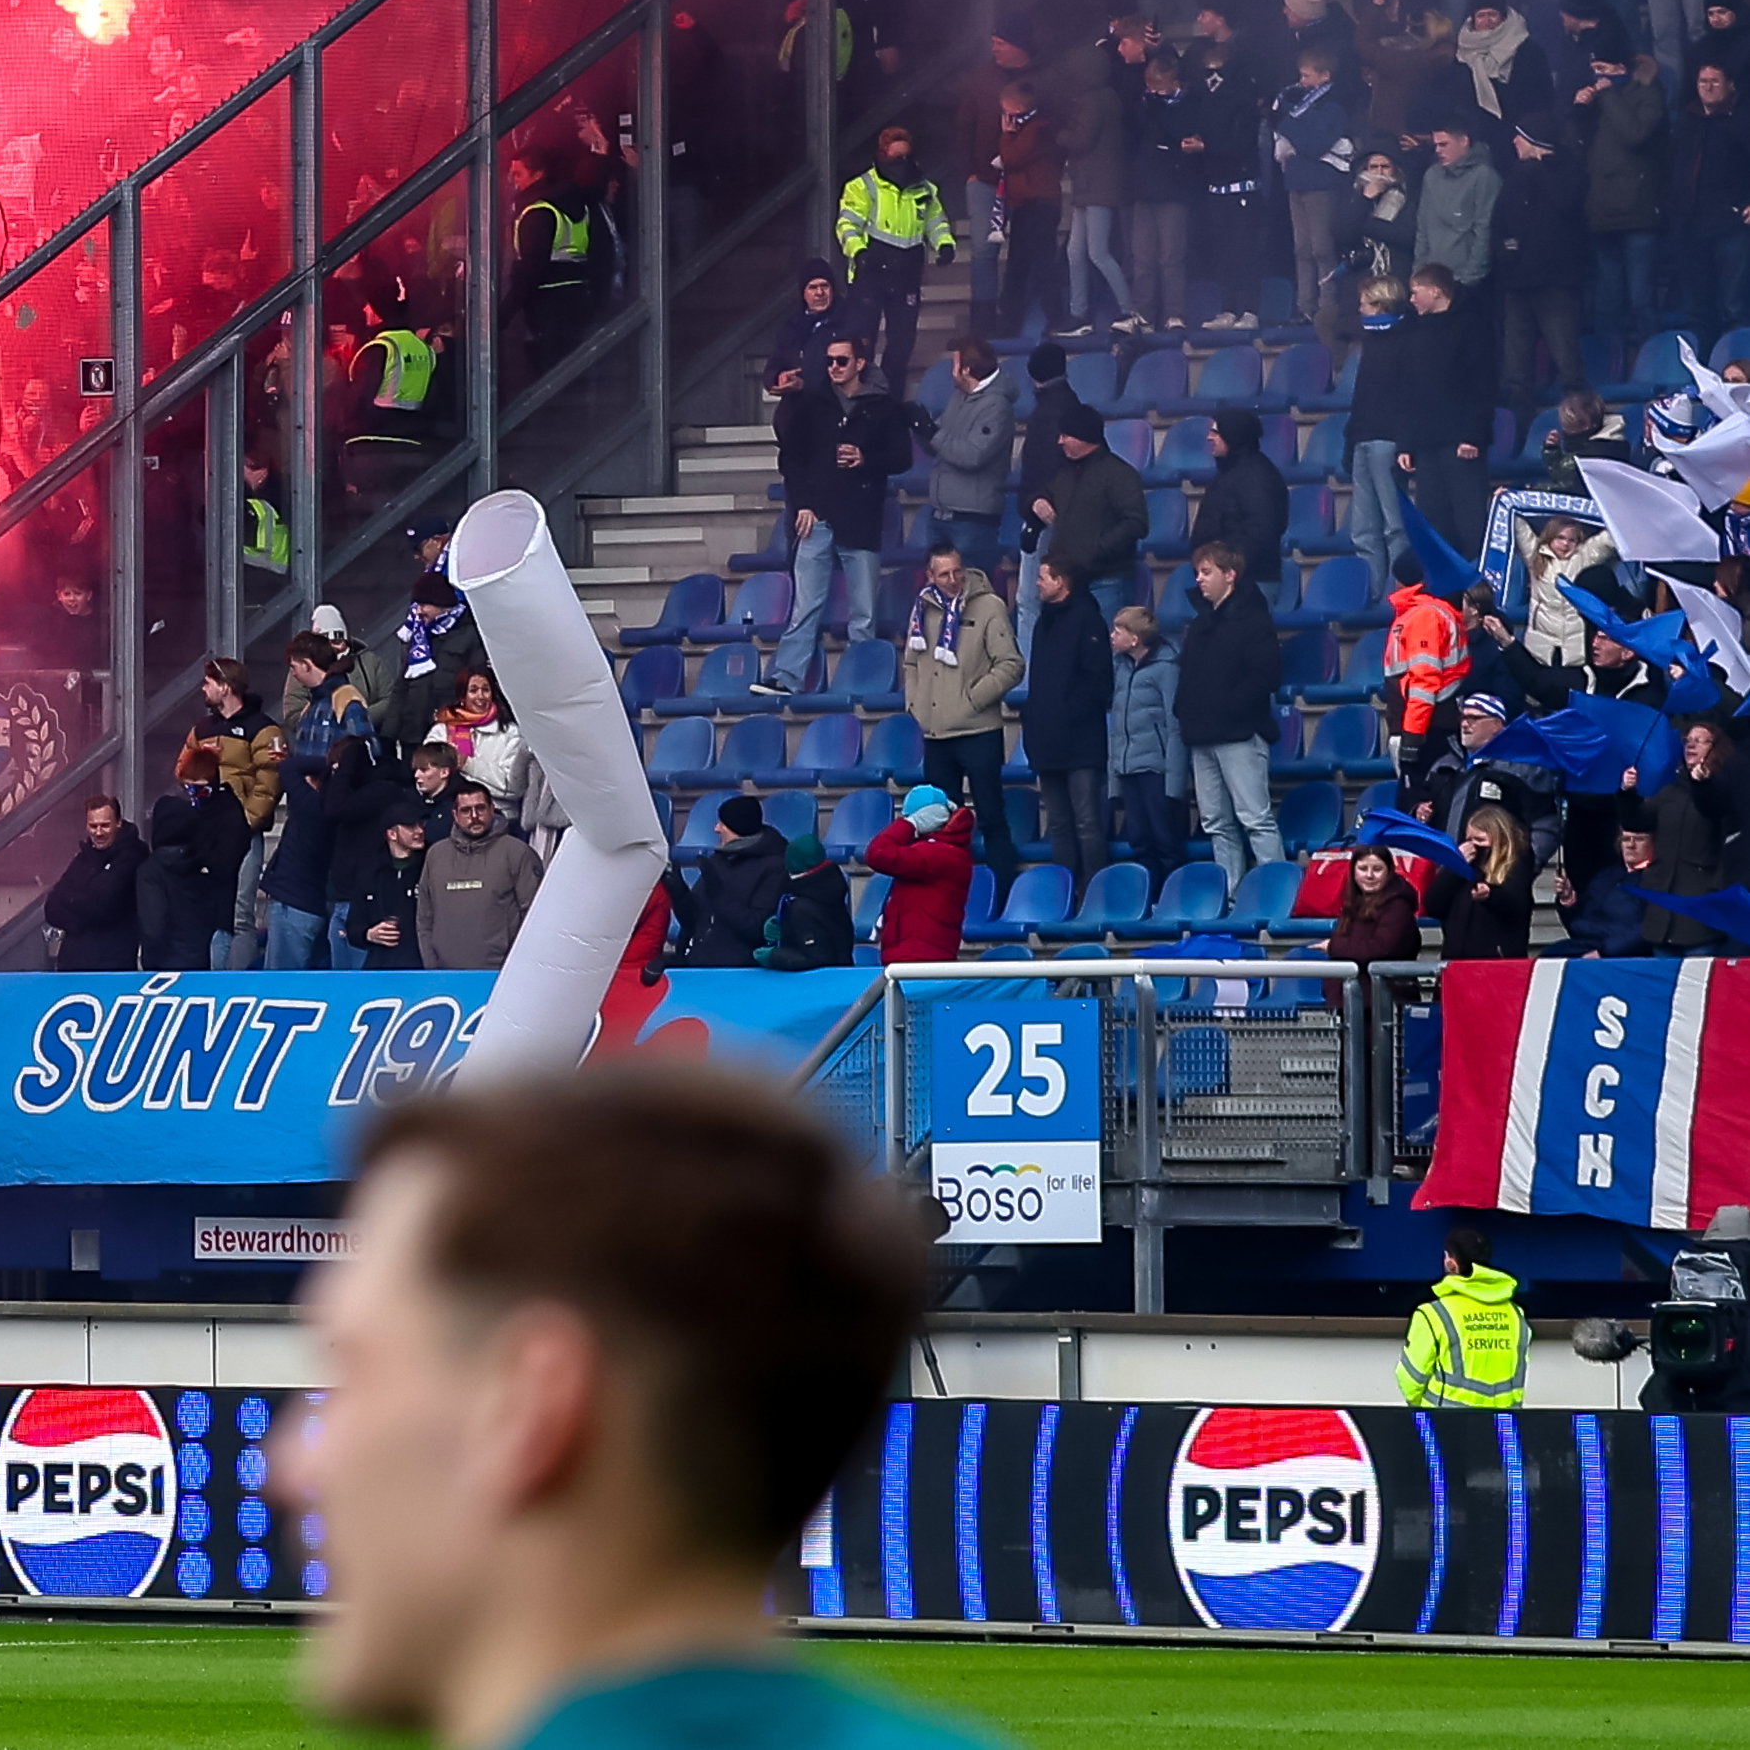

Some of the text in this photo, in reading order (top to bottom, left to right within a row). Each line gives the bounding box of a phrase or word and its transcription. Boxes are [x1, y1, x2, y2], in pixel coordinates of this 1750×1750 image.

[13, 972, 327, 1114] SÚNT
[963, 1022, 1067, 1118] 25
[1046, 1174, 1066, 1193] for
[1071, 1174, 1096, 1193] life!
[1467, 1338, 1510, 1350] SERVICE
[5, 1460, 165, 1516] PEPSI
[1182, 1486, 1366, 1546] PEPSI
